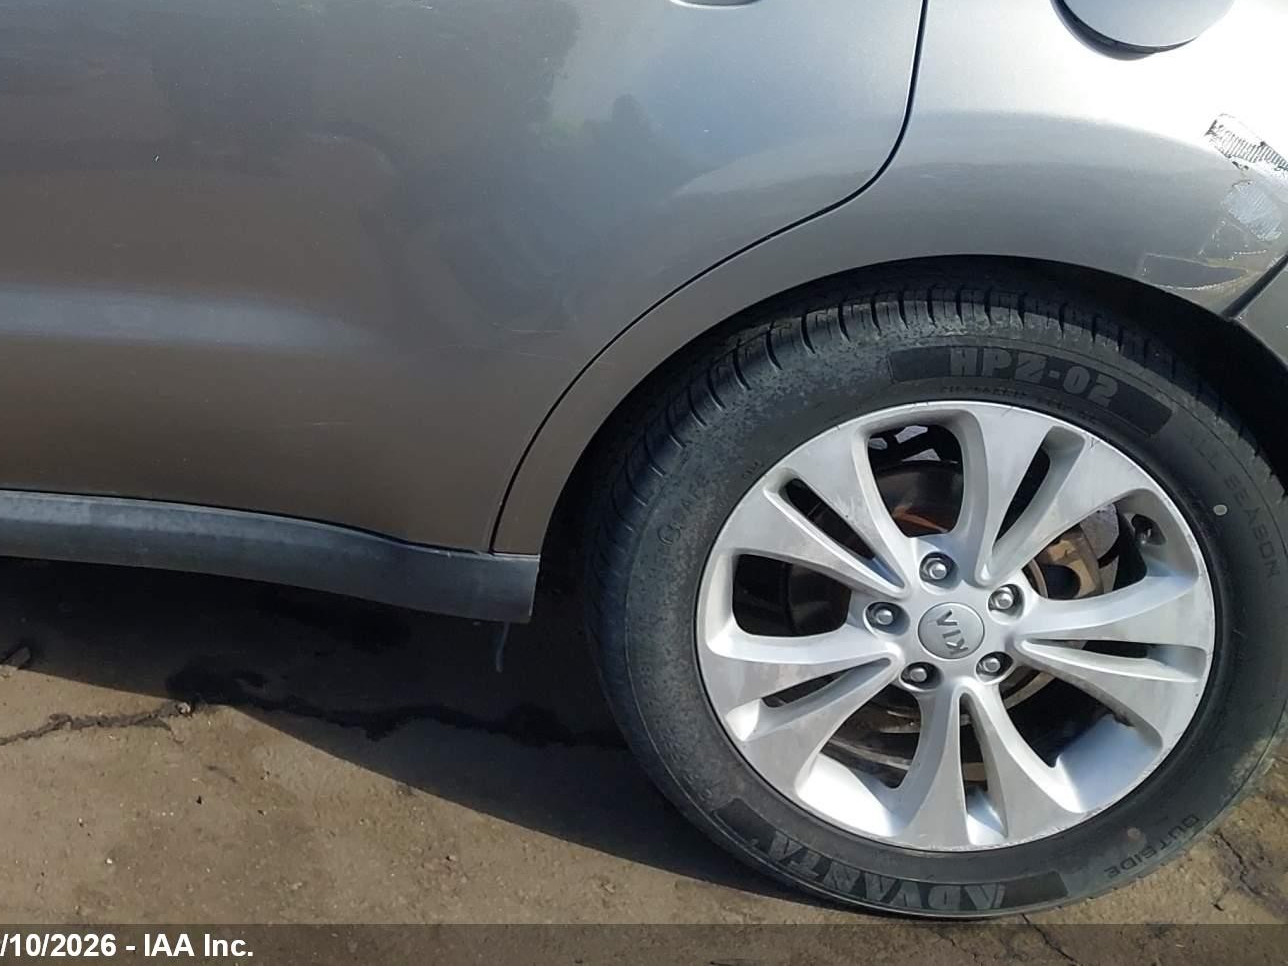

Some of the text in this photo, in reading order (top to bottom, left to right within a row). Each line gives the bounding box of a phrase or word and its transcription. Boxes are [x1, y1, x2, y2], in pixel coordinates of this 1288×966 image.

[949, 346, 1119, 409] HPZ-02
[1223, 472, 1281, 580] SEASON
[935, 609, 969, 655] KIA
[767, 831, 1005, 911] ADVANTA
[1103, 813, 1201, 879] OUTSIDE
